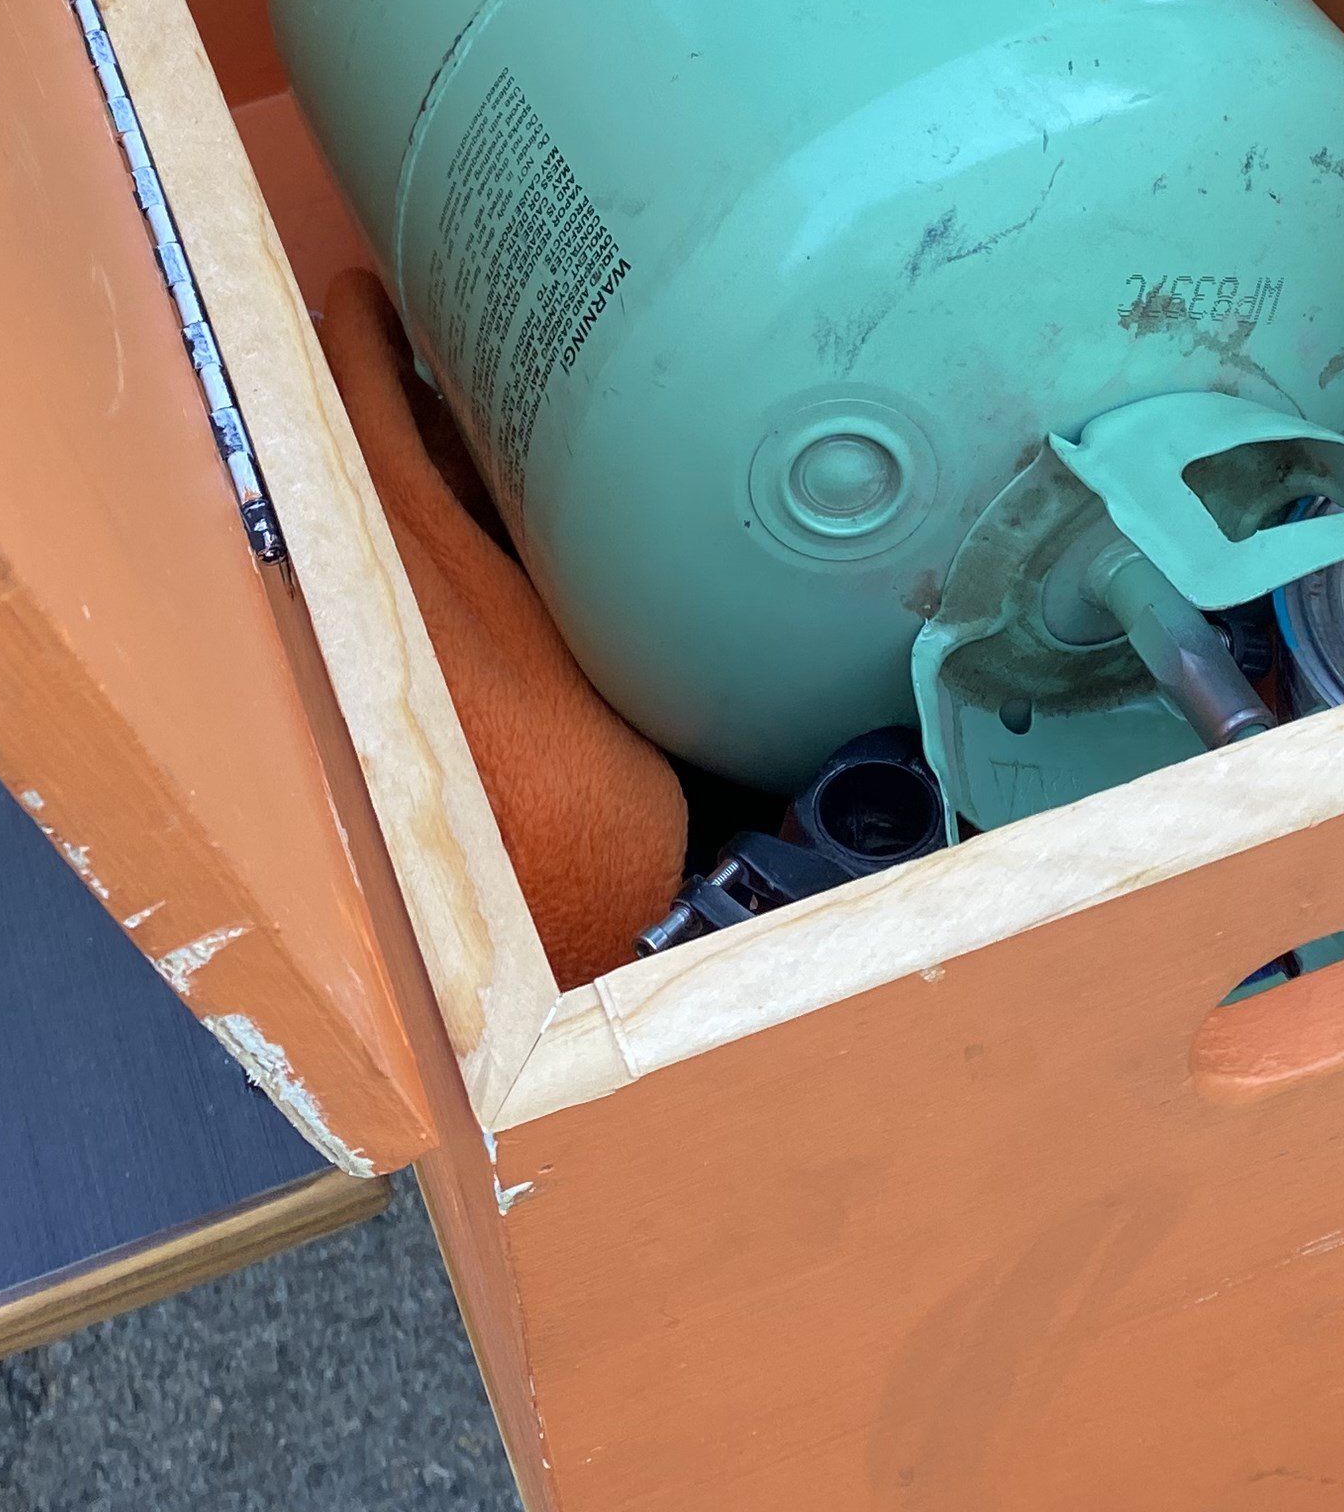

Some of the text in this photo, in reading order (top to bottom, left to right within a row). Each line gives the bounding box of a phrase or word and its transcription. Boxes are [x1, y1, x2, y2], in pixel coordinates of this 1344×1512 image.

[485, 64, 509, 103] closed
[490, 73, 515, 113] unless
[504, 83, 521, 109] Use
[468, 99, 487, 132] when
[487, 109, 503, 136] with
[504, 92, 527, 128] Avoid
[506, 101, 531, 141] sparks
[524, 111, 538, 132] Do
[454, 146, 463, 161] in
[455, 114, 488, 175] adequately
[459, 128, 471, 150] not
[472, 128, 504, 182] breathing
[494, 137, 509, 163] and
[509, 132, 523, 156] not
[515, 120, 544, 166] cylinder
[536, 131, 550, 151] Do
[461, 135, 488, 188] adequate
[492, 155, 510, 184] drop
[505, 169, 514, 184] in
[515, 154, 534, 186] NOT
[538, 144, 559, 175] MAY
[540, 153, 564, 191] NESS
[484, 186, 493, 202] or
[513, 170, 541, 218] CAUSE
[549, 162, 571, 194] MAY
[555, 171, 576, 204] AND
[458, 185, 474, 217] vapor
[472, 203, 485, 230] refill
[486, 185, 505, 221] direct
[495, 187, 514, 222] apply
[527, 188, 541, 212] OR
[545, 201, 556, 219] IS
[550, 180, 582, 228] VAPOR
[475, 222, 487, 245] sun
[521, 195, 549, 242] CAUSE
[464, 231, 474, 253] this
[479, 225, 496, 259] direct
[515, 217, 546, 275] HEAVIER
[549, 203, 595, 276] SURFACES
[560, 212, 601, 277] CONTACT
[569, 222, 607, 281] VIOLENT
[500, 243, 522, 288] HEART
[518, 227, 552, 290] REDUCES
[485, 261, 504, 306] LIQUID
[501, 274, 518, 312] THAN
[535, 281, 548, 303] TO
[539, 231, 613, 360] OVERPRESSURIZING
[540, 277, 560, 313] WITH
[571, 285, 590, 317] AND
[498, 289, 521, 344] OXYGEN
[536, 279, 570, 345] CYLINDER
[558, 254, 631, 377] WARNING!
[474, 305, 489, 363] CONTACT
[509, 307, 535, 373] PRODUCE
[518, 315, 541, 368] FLAMES
[556, 315, 573, 346] GAS
[511, 371, 522, 393] OR
[527, 365, 540, 395] MAY
[538, 345, 559, 392] UNDER
[517, 399, 531, 442] CAUSE
